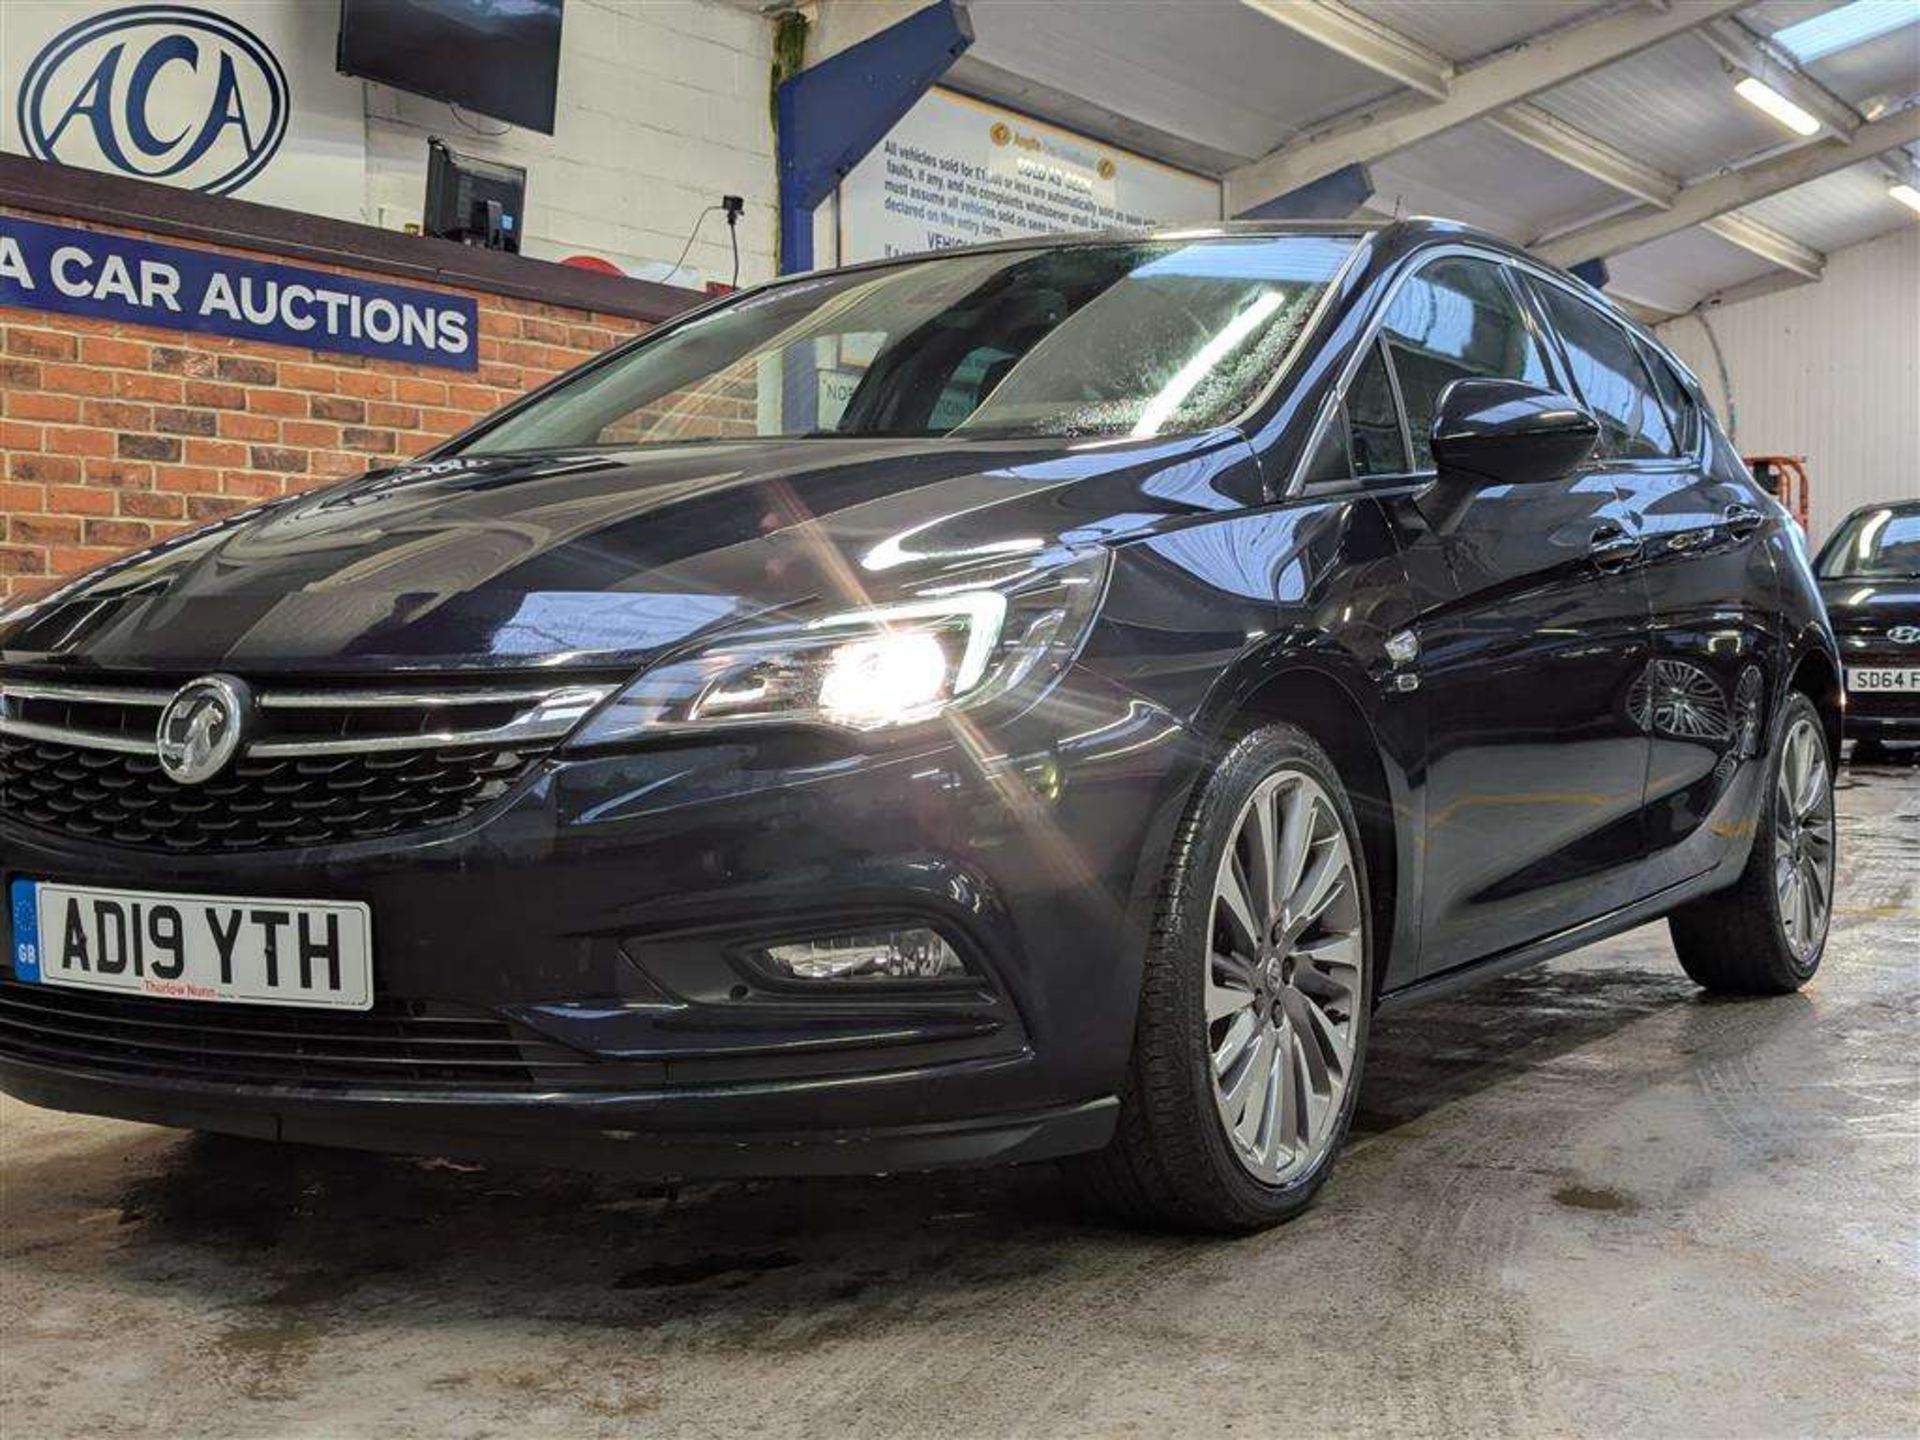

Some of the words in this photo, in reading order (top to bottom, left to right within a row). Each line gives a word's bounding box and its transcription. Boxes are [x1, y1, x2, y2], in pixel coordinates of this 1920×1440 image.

[42, 33, 255, 178] ACA
[884, 139, 897, 155] All
[899, 145, 937, 168] vehicles
[939, 157, 959, 174] sold
[961, 161, 973, 178] for
[1047, 187, 1097, 217] automatically
[946, 179, 964, 194] and
[965, 184, 978, 197] no
[979, 187, 1024, 211] complaints
[1025, 202, 1069, 222] whatsoever
[884, 180, 908, 198] must
[910, 186, 945, 208] assume
[947, 196, 959, 209] all
[960, 201, 996, 220] vehicles
[997, 210, 1015, 226] sold
[1016, 215, 1026, 228] as
[1027, 219, 1046, 232] seen
[884, 196, 925, 219] declared
[926, 209, 938, 222] on
[940, 211, 955, 227] the
[957, 218, 979, 237] entry
[50, 246, 182, 312] CAR
[199, 272, 469, 355] AUCTIONS
[1857, 671, 1904, 688] SD64
[18, 944, 35, 963] GB
[62, 898, 184, 980] AD19
[205, 908, 341, 991] YTH
[144, 980, 185, 996] Thurlow
[187, 985, 217, 998] Nunn
